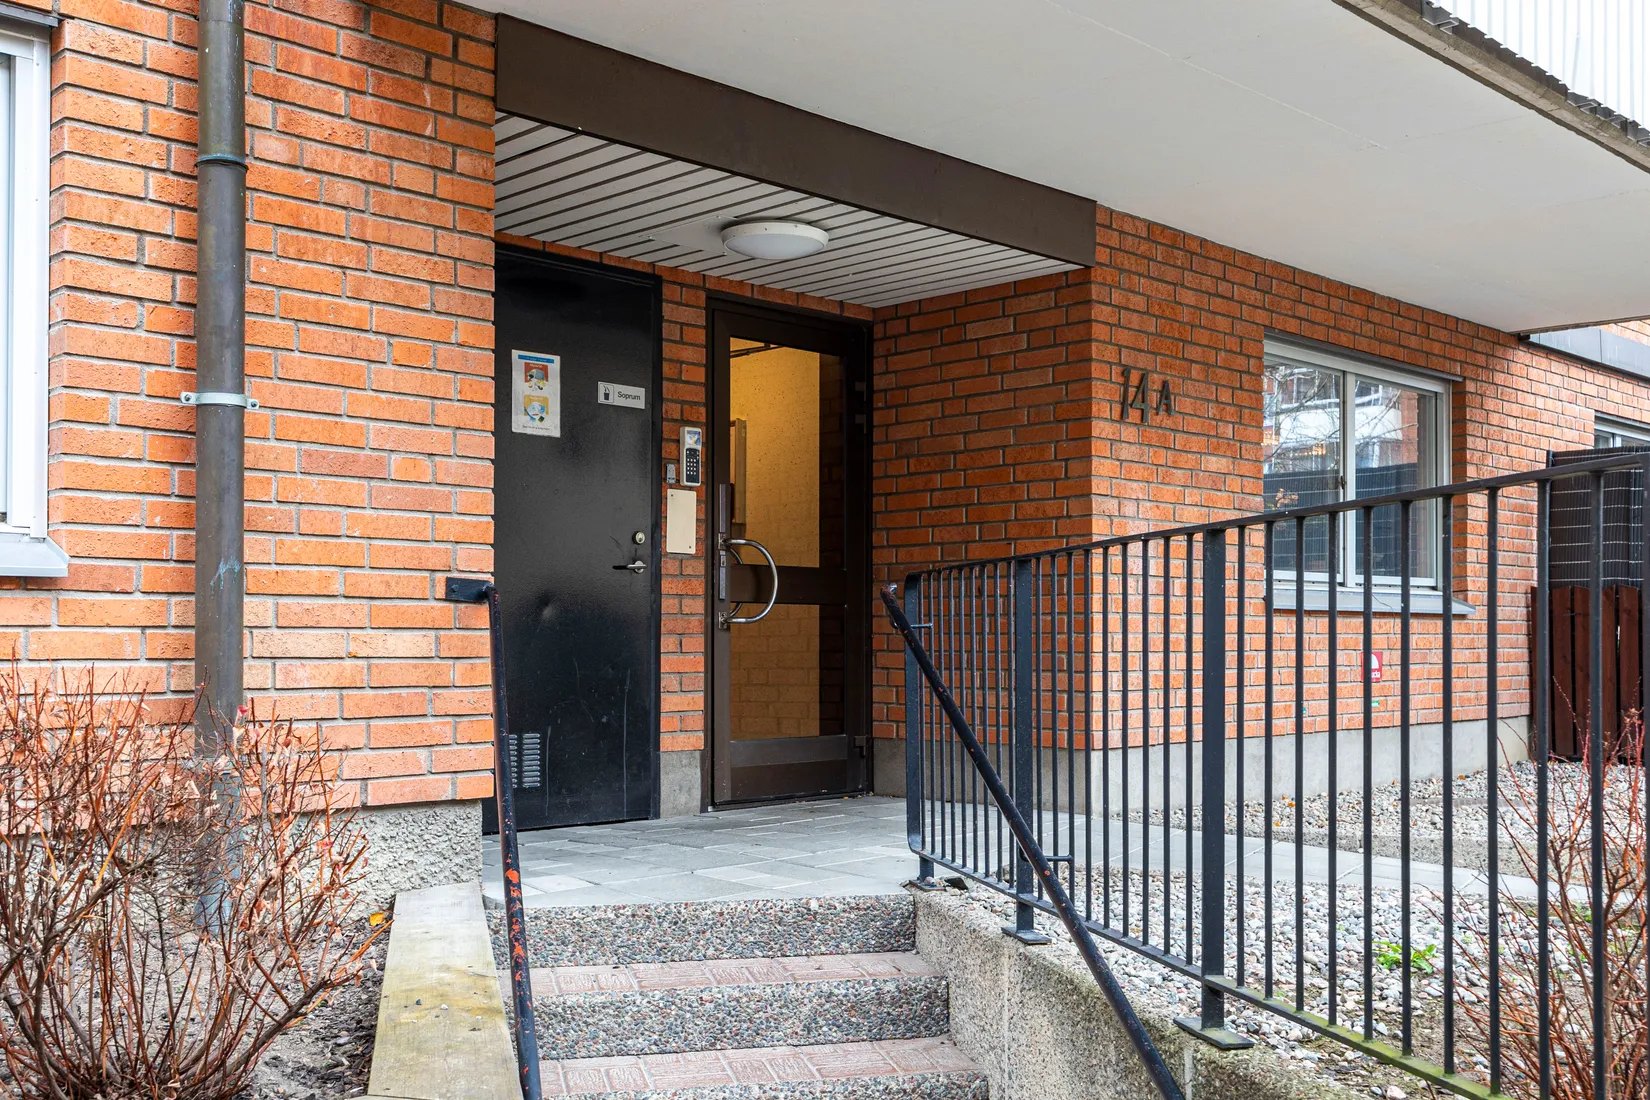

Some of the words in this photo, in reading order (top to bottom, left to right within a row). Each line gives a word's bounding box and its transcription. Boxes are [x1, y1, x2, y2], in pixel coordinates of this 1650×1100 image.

[617, 390, 641, 401] Soprum
[1122, 368, 1149, 422] 14
[1158, 380, 1175, 415] A
